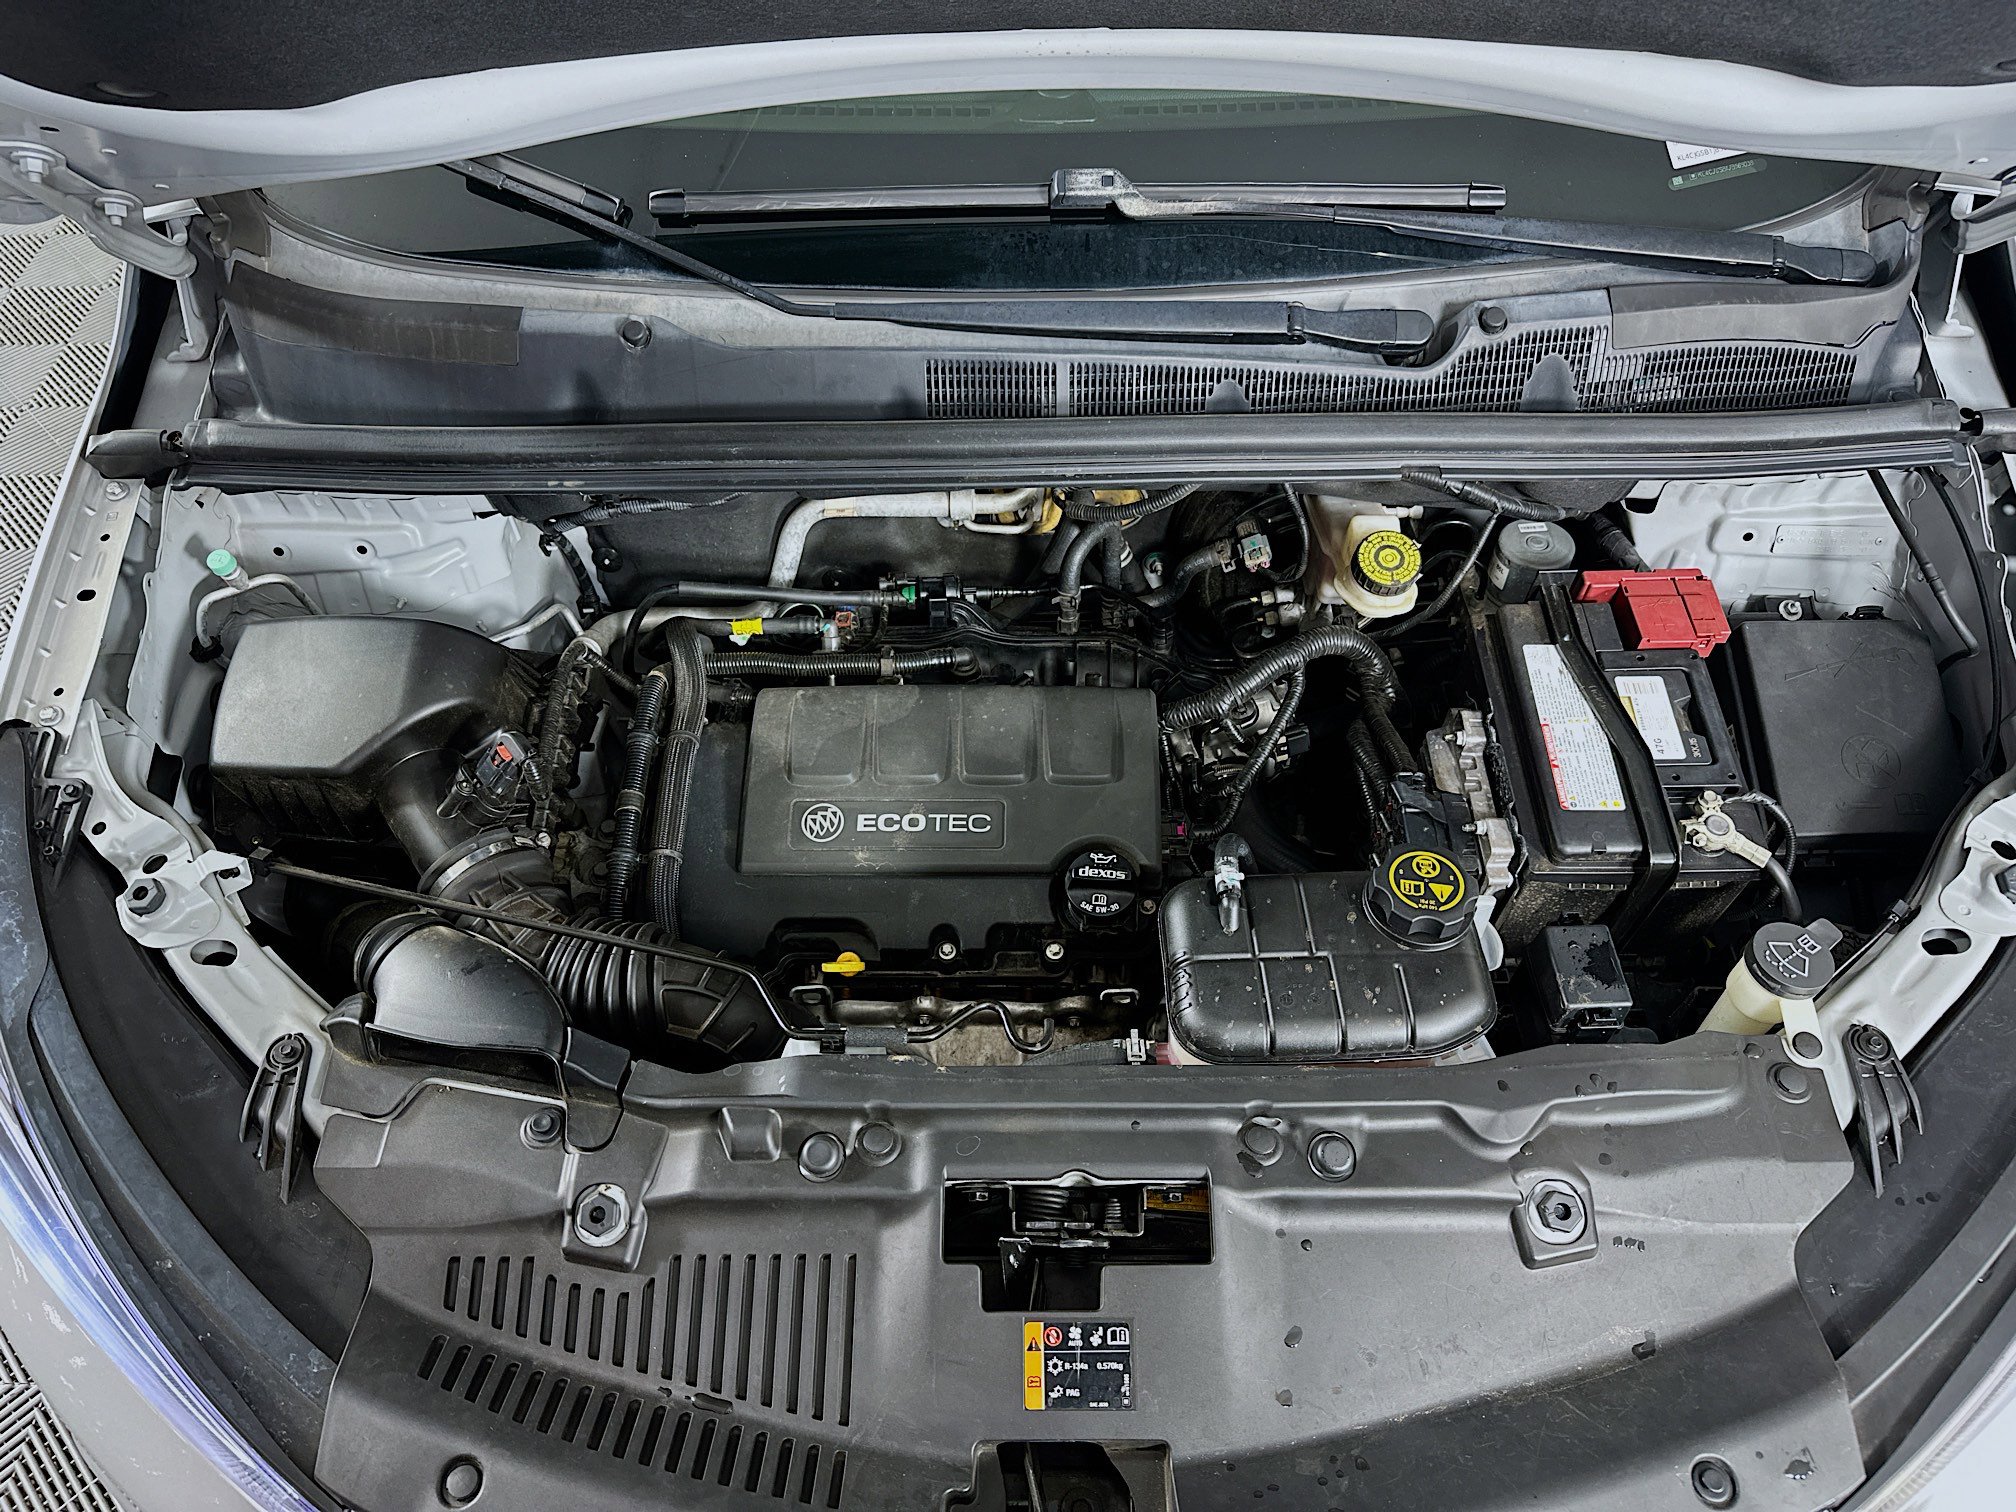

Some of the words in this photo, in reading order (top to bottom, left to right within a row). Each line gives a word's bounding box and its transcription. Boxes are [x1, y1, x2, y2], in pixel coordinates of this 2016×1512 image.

[856, 813, 992, 832] ECOTEC
[1078, 866, 1127, 880] dexos
[1080, 901, 1093, 912] SAE
[1095, 903, 1120, 913] 5W-30
[1064, 1362, 1088, 1370] R-134a
[1065, 1388, 1080, 1397] PAG
